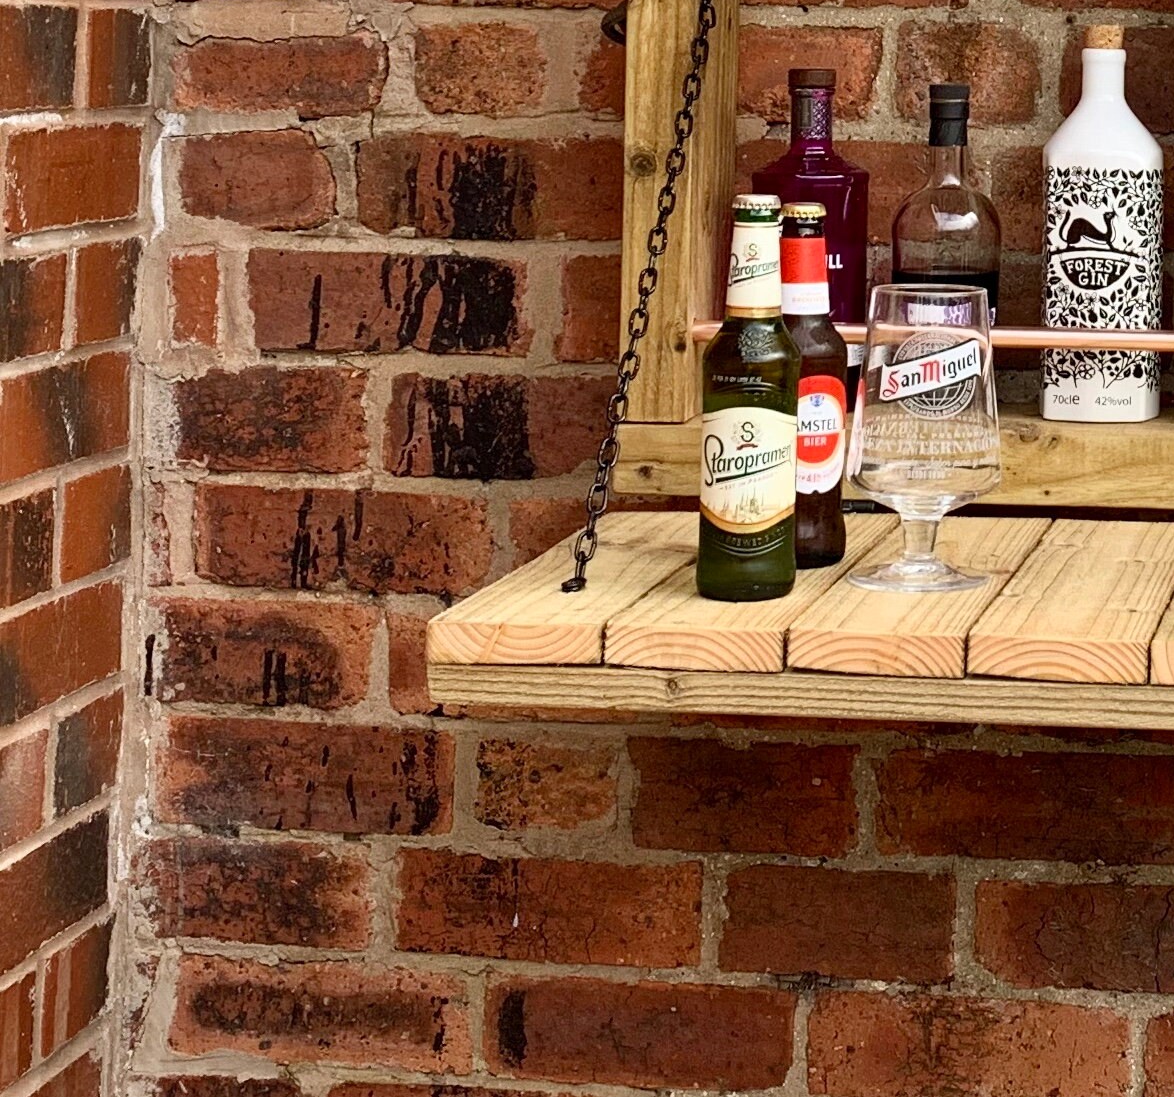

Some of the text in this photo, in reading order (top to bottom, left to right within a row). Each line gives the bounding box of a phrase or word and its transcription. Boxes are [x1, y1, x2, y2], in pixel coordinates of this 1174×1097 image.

[728, 252, 780, 287] Staroprame
[1064, 258, 1129, 276] FOREST
[1078, 272, 1110, 287] GIN
[797, 418, 838, 432] MSTEL
[803, 436, 828, 448] BIER
[704, 434, 792, 487] Staropramen
